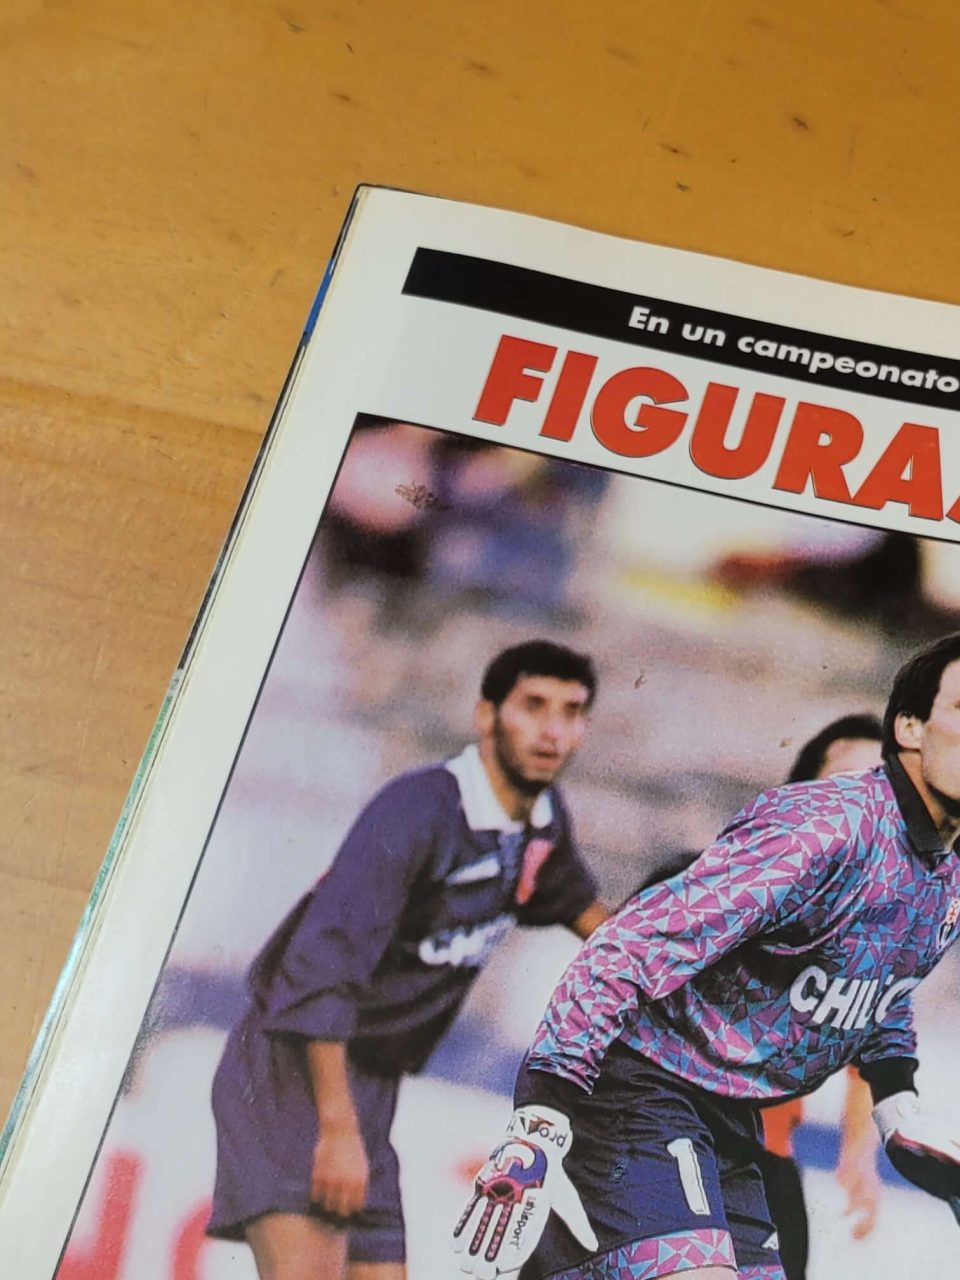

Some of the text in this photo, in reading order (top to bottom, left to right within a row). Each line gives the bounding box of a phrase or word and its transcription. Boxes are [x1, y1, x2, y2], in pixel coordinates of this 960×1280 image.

[628, 305, 669, 335] En
[681, 322, 727, 347] un
[736, 336, 960, 394] campeonato
